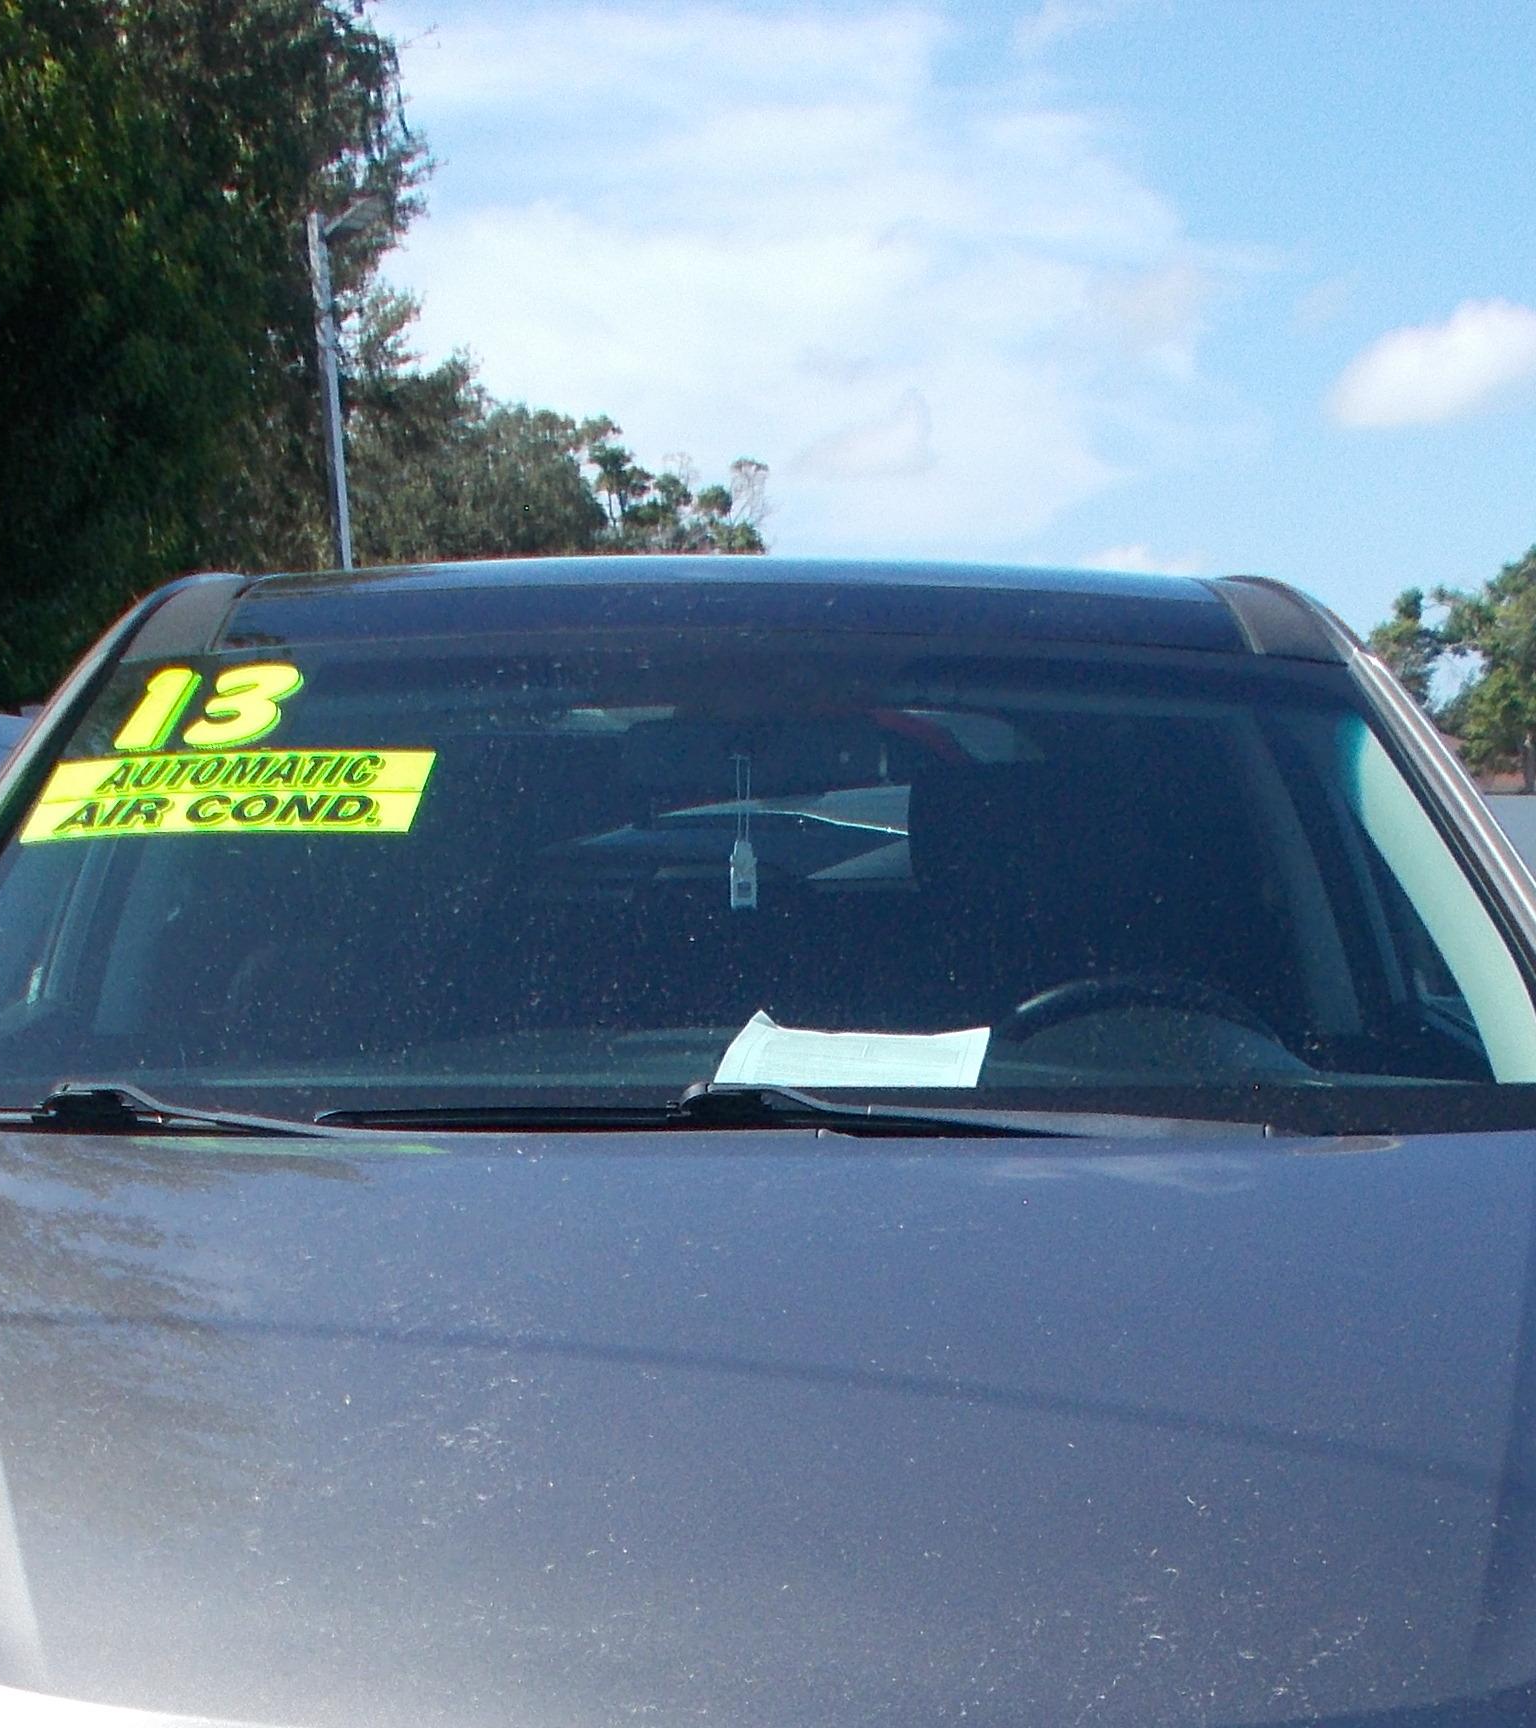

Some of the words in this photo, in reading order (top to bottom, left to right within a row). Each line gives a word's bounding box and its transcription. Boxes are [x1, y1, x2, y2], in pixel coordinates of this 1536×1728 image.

[114, 664, 304, 751] 13
[97, 755, 386, 793] AUTOMATIC
[53, 796, 175, 834] AIR
[185, 794, 383, 827] COND.
